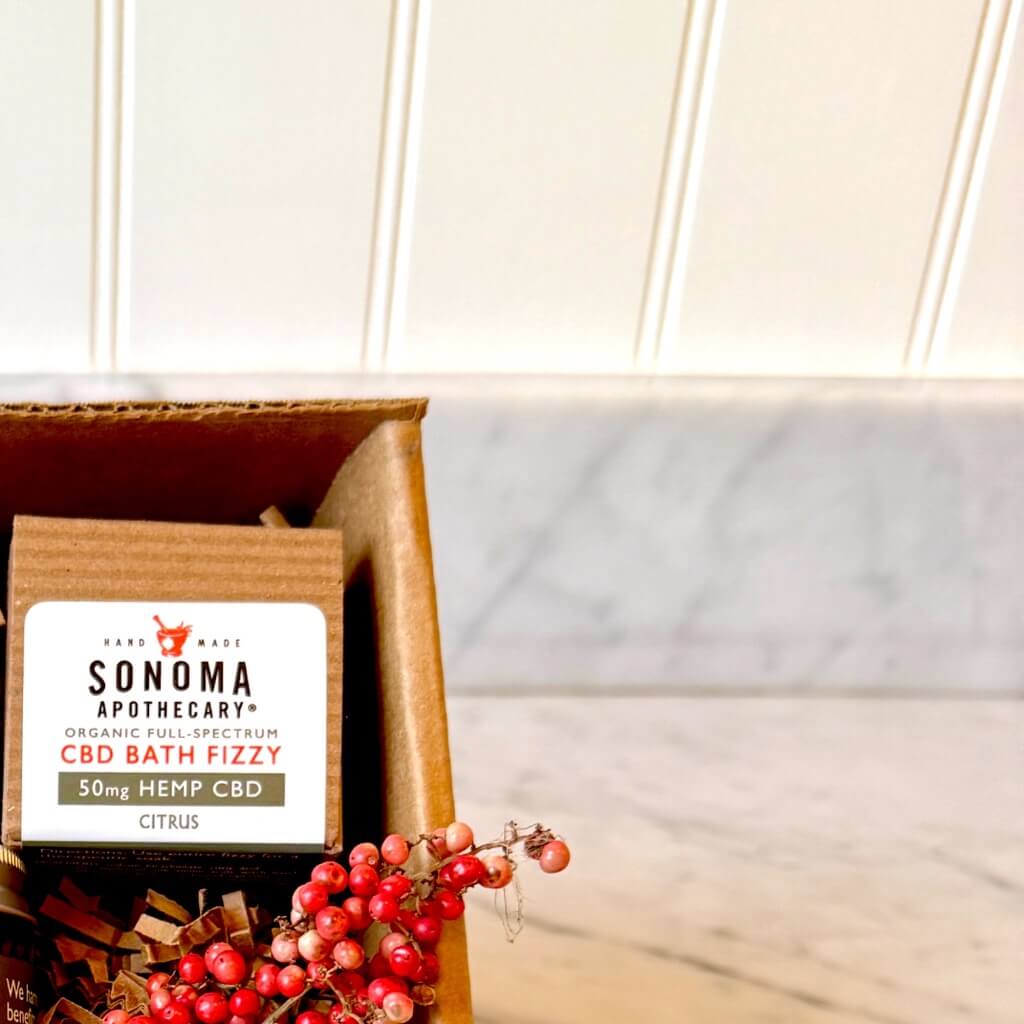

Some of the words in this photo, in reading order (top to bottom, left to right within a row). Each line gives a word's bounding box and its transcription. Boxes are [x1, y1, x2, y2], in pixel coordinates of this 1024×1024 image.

[104, 638, 145, 648] HAND
[198, 638, 241, 648] MADE
[88, 660, 251, 697] SONOMA
[65, 727, 140, 739] ORGANIC
[148, 728, 278, 739] FULL-SPECTRUM
[60, 745, 113, 764] CBD
[126, 745, 195, 765] BATH
[208, 745, 282, 765] FIZZY
[78, 779, 129, 801] 50mg
[140, 780, 202, 797] HEMP
[212, 780, 262, 798] CBD
[139, 814, 199, 829] CITRUS
[6, 978, 24, 1000] We
